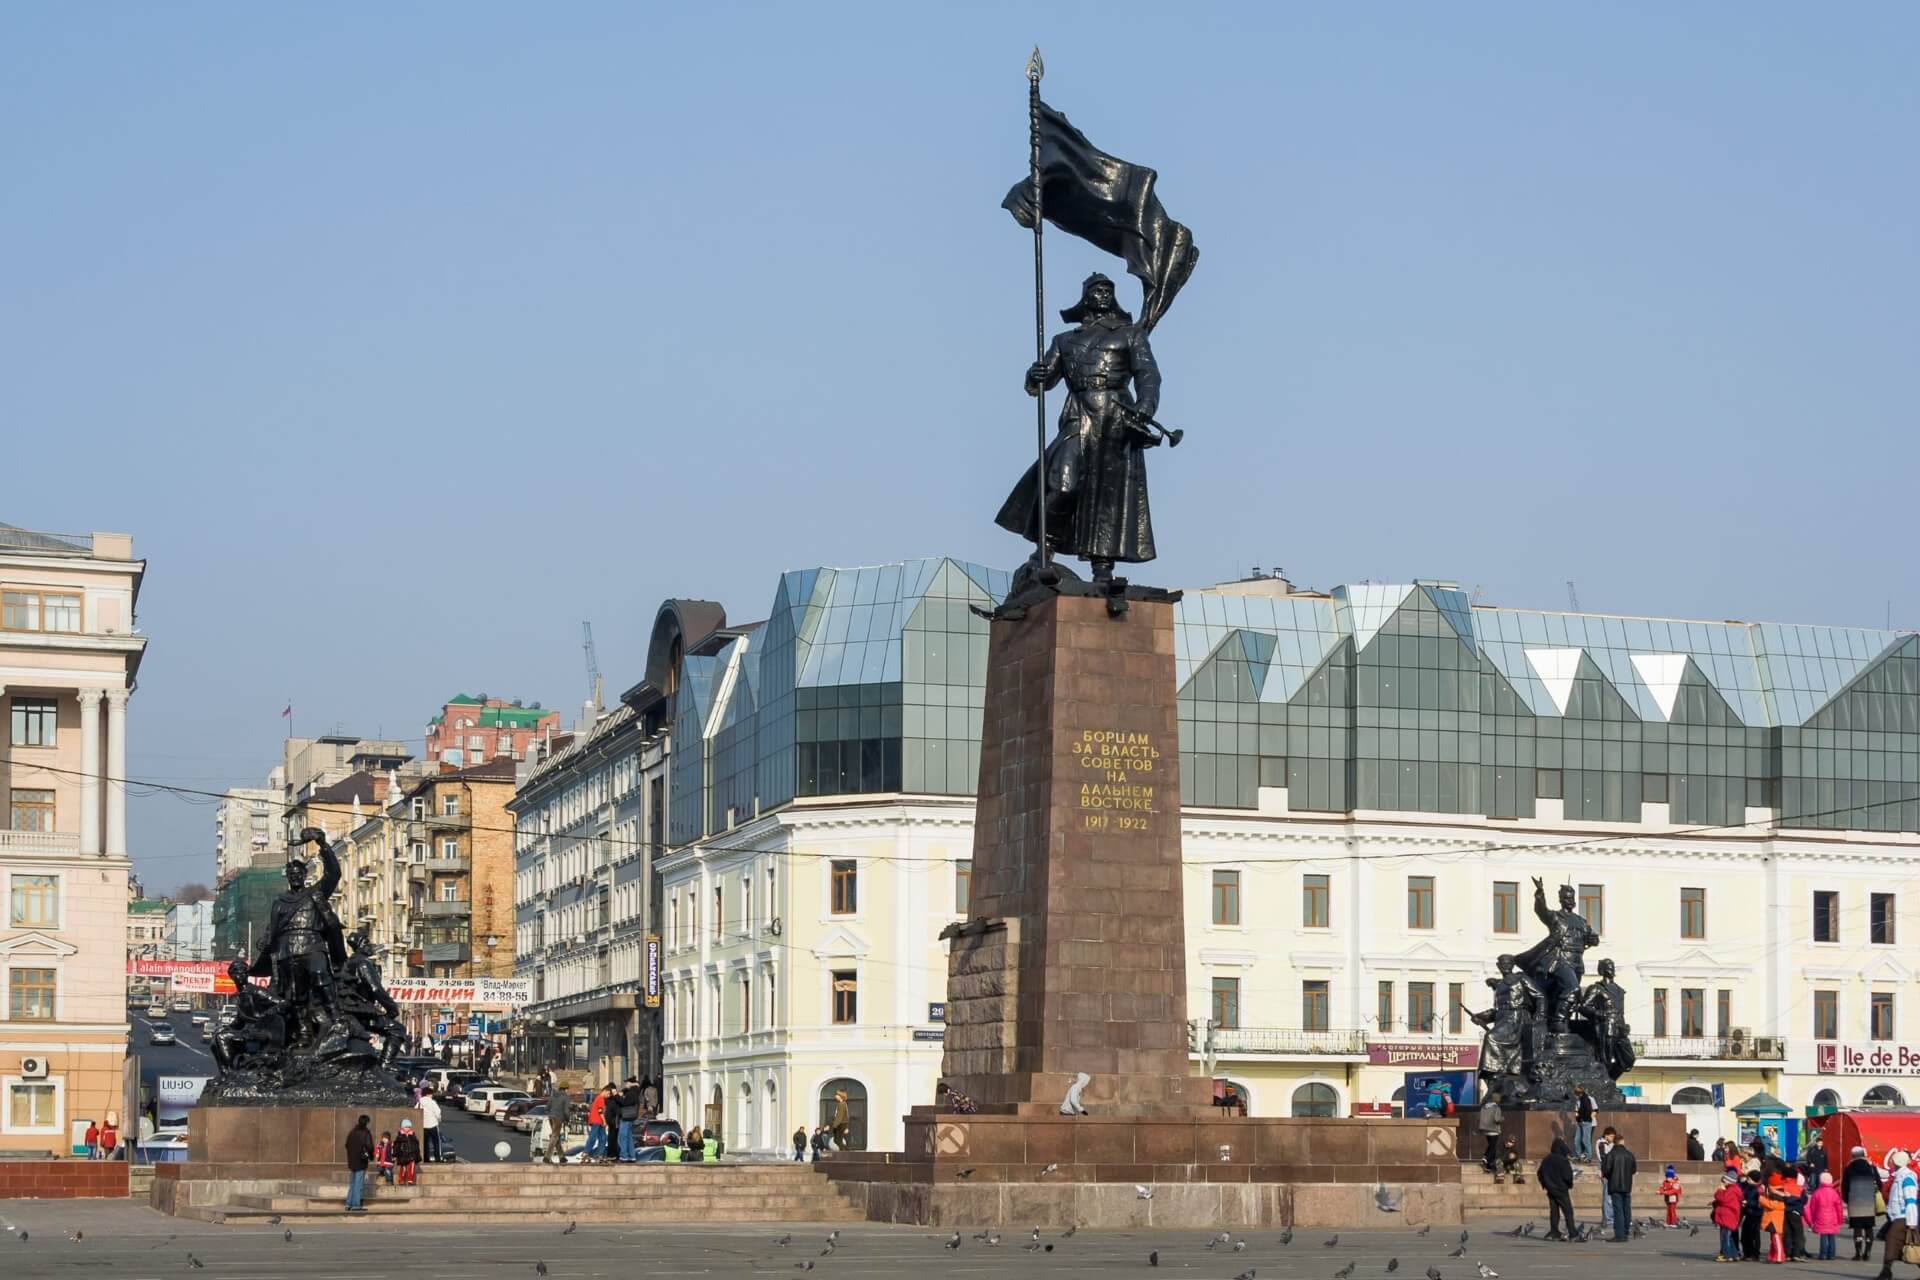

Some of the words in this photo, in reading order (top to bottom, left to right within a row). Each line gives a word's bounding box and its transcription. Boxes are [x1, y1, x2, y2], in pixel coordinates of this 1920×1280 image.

[1083, 730, 1149, 745] БОРЦАМ
[1072, 742, 1093, 755] ЗА
[1101, 745, 1160, 758] ВЛАСТЬ
[1081, 757, 1153, 771] СОВЕТОВ
[1106, 771, 1127, 783] НА
[1081, 784, 1153, 798] ДАЛЬНЕМ
[1081, 796, 1152, 810] ВОСТОКЕ
[1388, 1051, 1459, 1065] ЦЕНТРАЛЬНЫЙ
[1870, 1046, 1893, 1066] de
